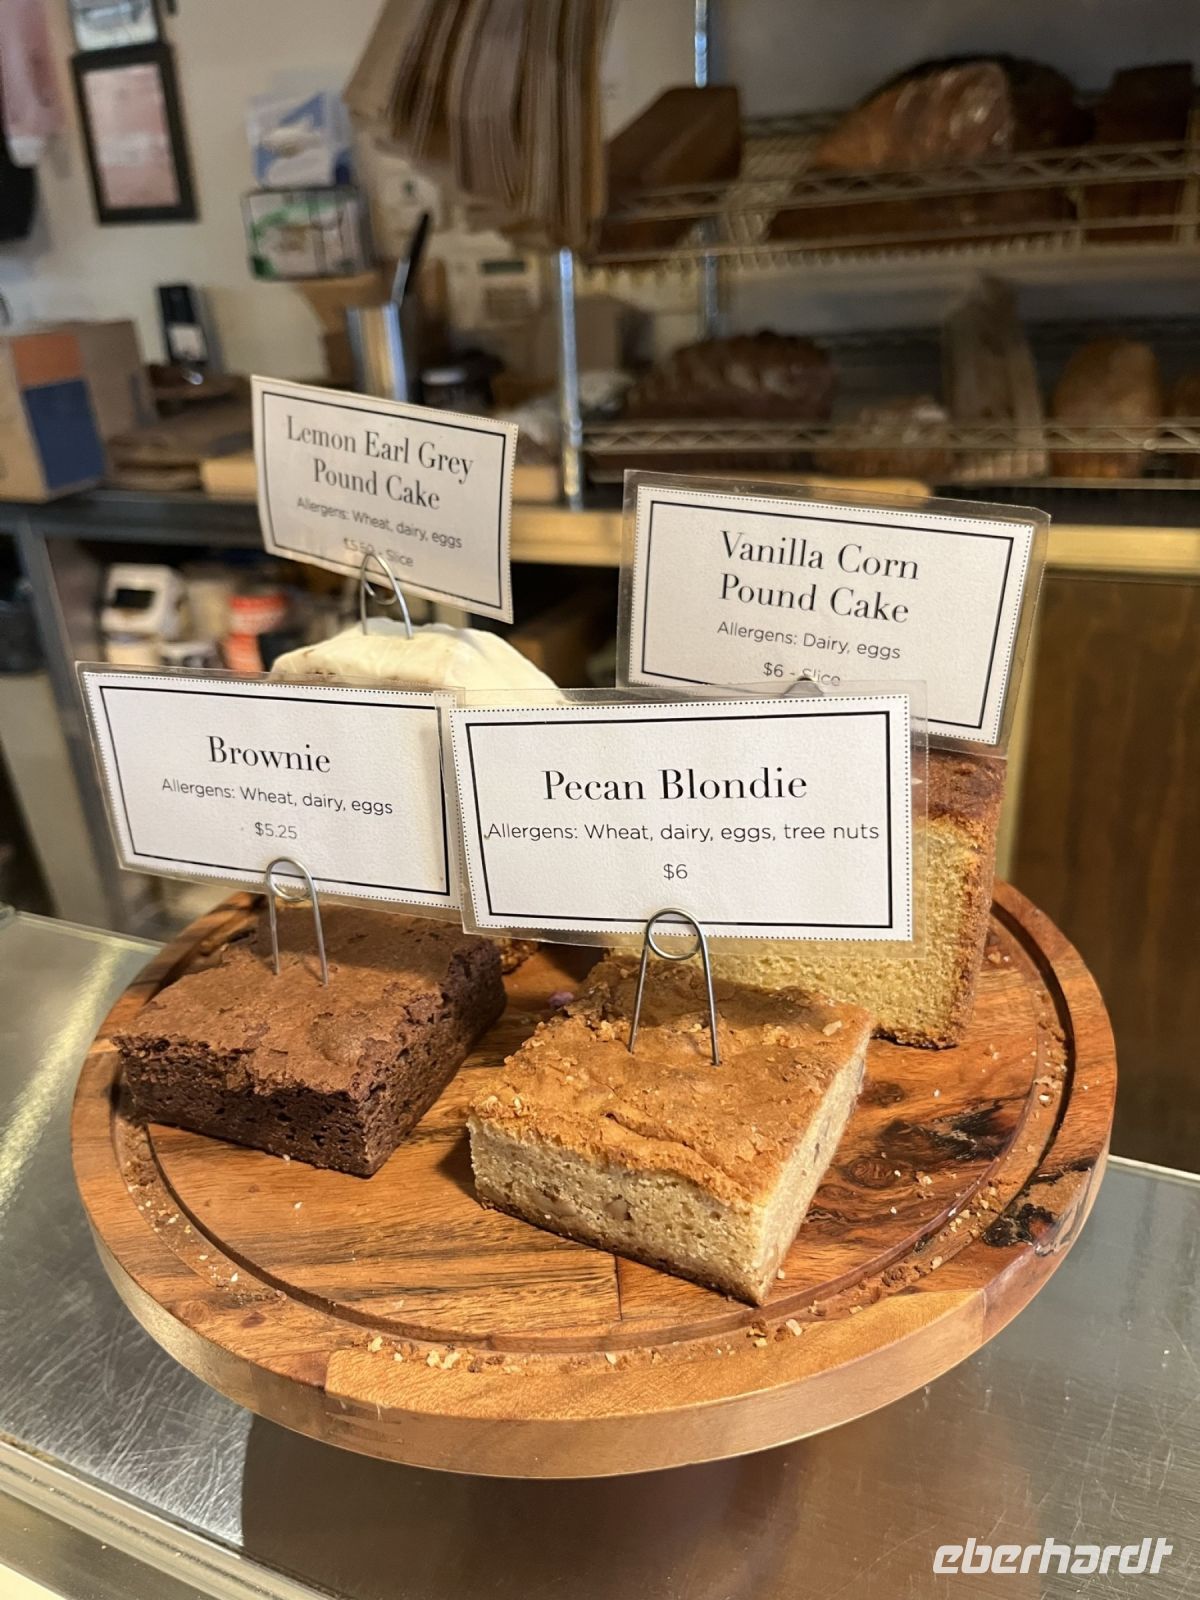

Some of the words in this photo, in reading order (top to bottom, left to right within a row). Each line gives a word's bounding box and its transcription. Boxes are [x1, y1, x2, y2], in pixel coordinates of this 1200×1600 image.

[286, 415, 356, 453] Lemon
[365, 431, 409, 464] Earl
[419, 442, 473, 484] Grey
[313, 458, 378, 496] Pound
[386, 475, 440, 510] Cake
[297, 497, 349, 520] Allergens:
[352, 510, 393, 532] Wheat,
[396, 521, 428, 541] dairy,
[432, 531, 462, 549] eggs
[386, 548, 414, 567] Slice
[720, 530, 824, 570] Vanilla
[837, 543, 919, 580] Corn
[720, 573, 817, 611] Pound
[830, 587, 910, 623] Cake
[717, 620, 797, 646] Allergens:
[803, 633, 850, 655] Dairy,
[856, 643, 901, 660] eggs
[763, 661, 784, 679] $6
[206, 735, 331, 773] Brownie
[162, 778, 235, 798] Allergens:
[239, 786, 297, 806] Wheat,
[302, 792, 346, 812] dairy,
[351, 799, 392, 816] eggs
[542, 769, 645, 800] Pecan
[659, 767, 808, 800] Blondie
[254, 822, 298, 839] $5.25
[487, 822, 578, 842] Allergens:
[584, 823, 654, 842] Wheat,
[660, 823, 713, 843] dairy,
[721, 825, 776, 843] eggs,
[784, 825, 824, 840] tree
[833, 824, 879, 840] nuts
[663, 863, 688, 880] $6
